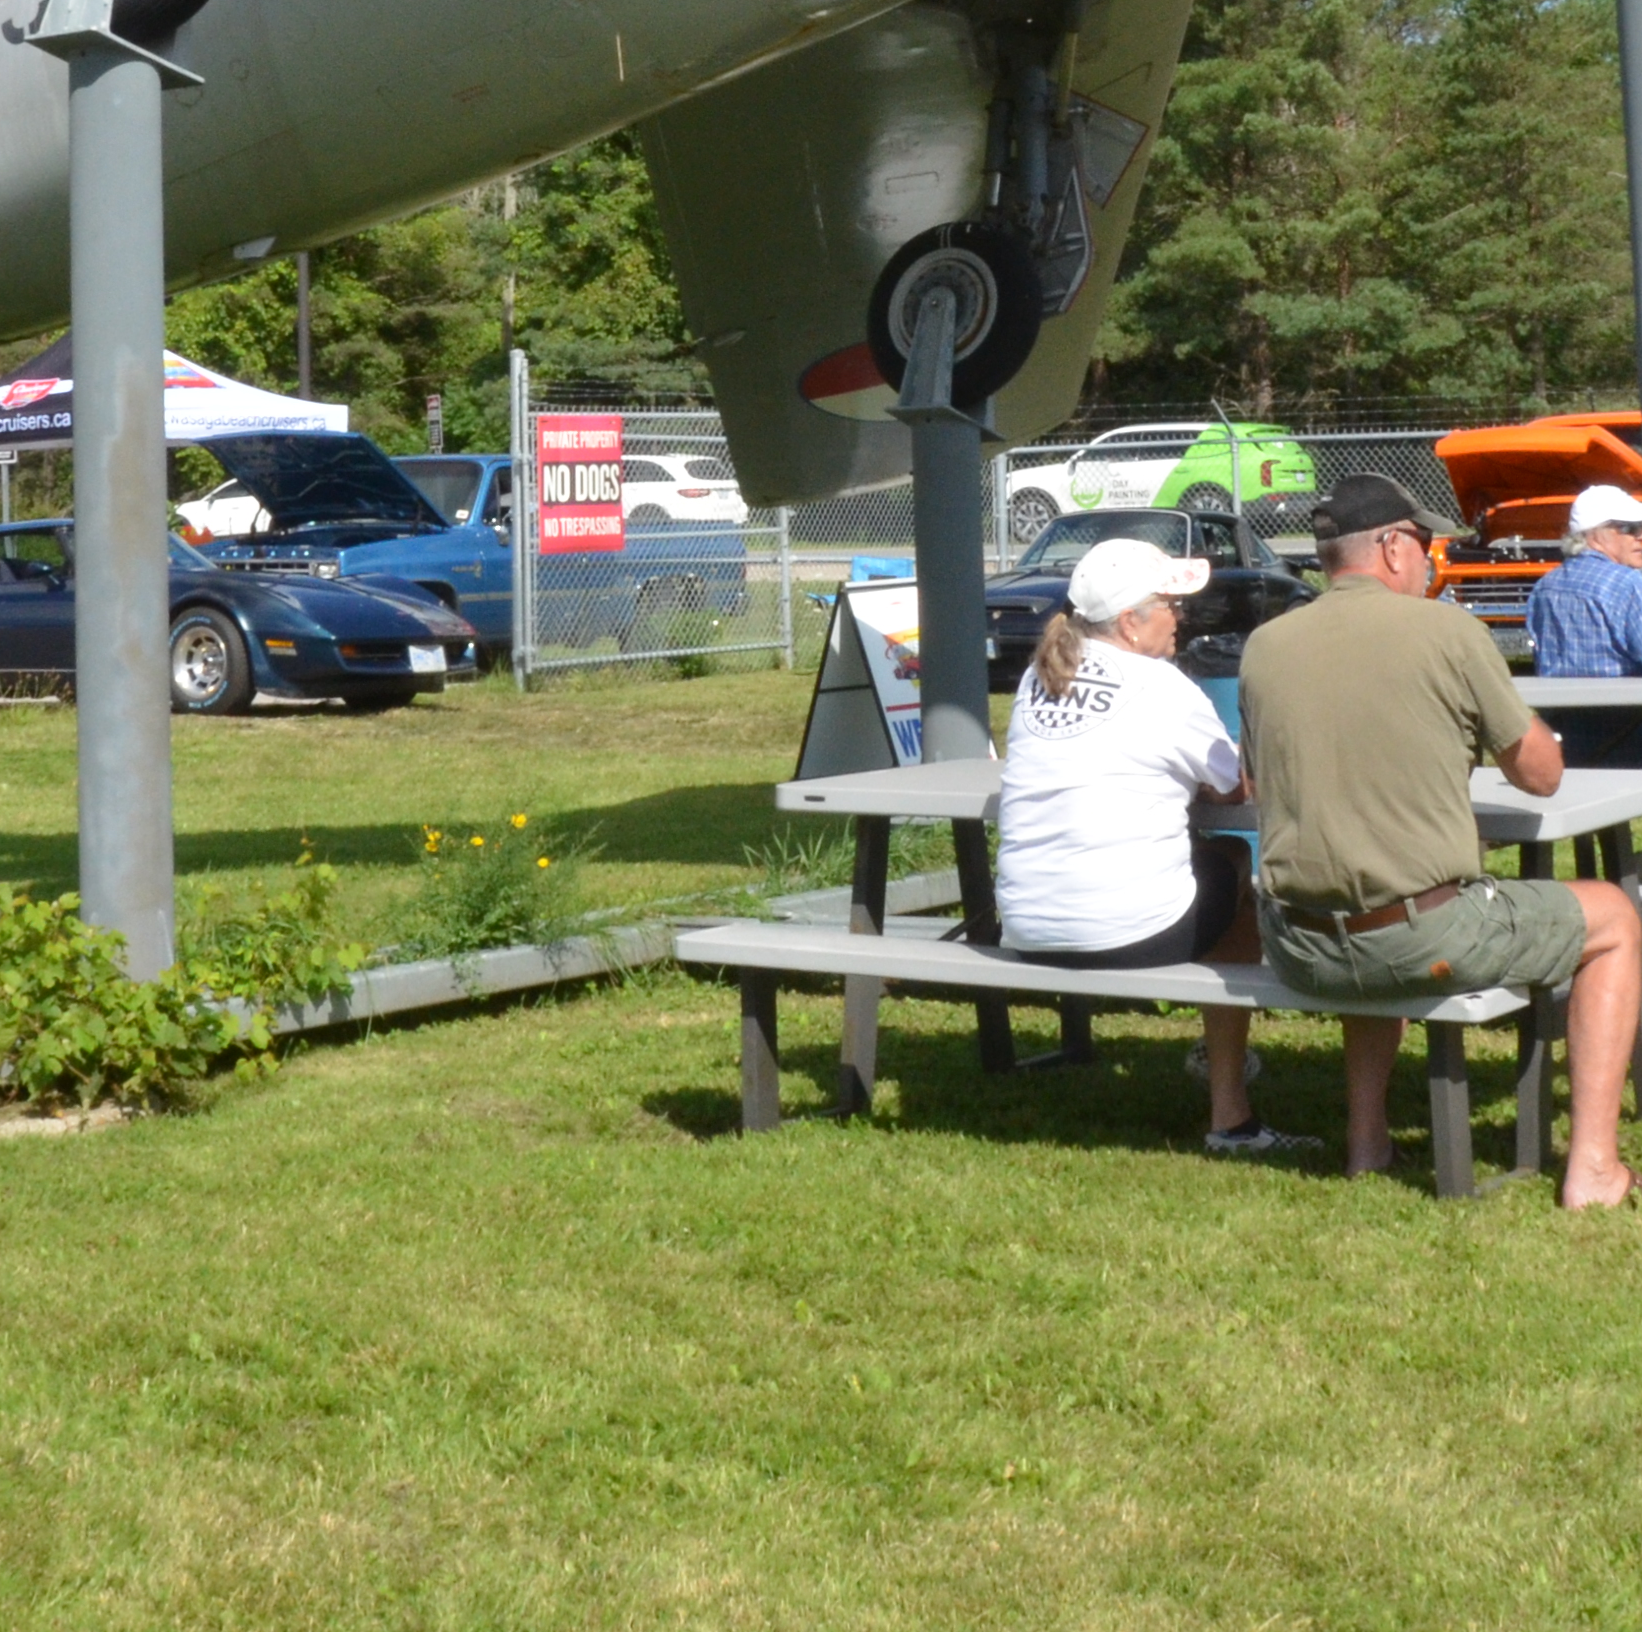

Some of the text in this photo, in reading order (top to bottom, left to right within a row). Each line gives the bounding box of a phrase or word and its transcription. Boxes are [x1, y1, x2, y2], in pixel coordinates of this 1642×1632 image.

[543, 430, 619, 449] PRIVATE PROPERTY
[543, 463, 620, 502] NO DOGS
[1108, 490, 1150, 499] PAINTING
[544, 516, 622, 538] NO TRESPASSING
